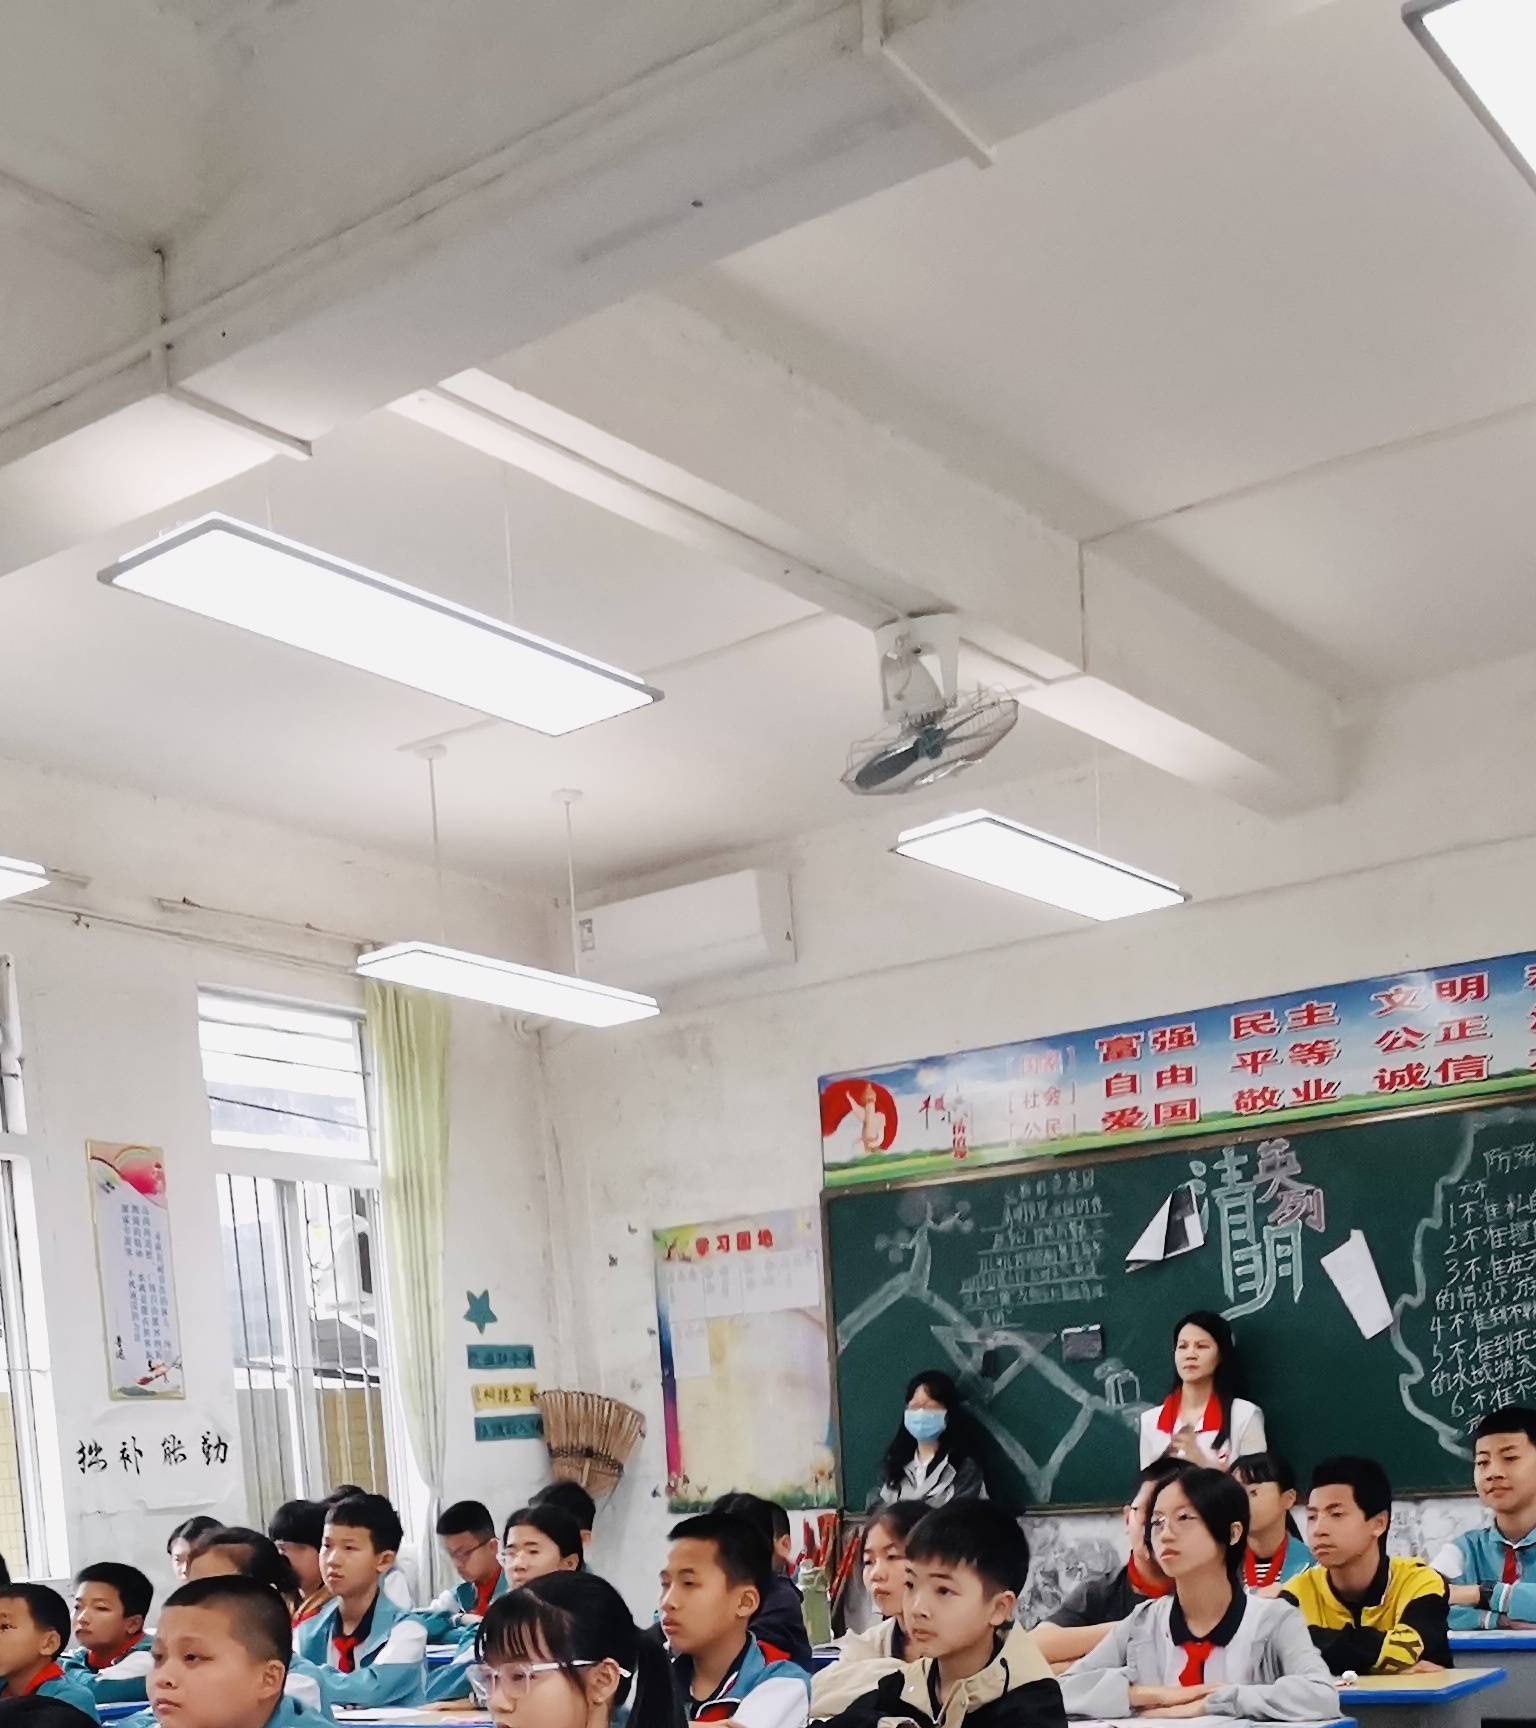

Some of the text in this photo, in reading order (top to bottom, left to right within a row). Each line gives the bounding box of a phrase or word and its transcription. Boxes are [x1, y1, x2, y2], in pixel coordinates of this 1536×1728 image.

[1098, 1023, 1199, 1063] 富强
[1231, 1000, 1341, 1040] 民主
[1370, 972, 1489, 1018] 文明
[1104, 1063, 1197, 1099] 自由
[1231, 1037, 1341, 1076] 平等
[1373, 1014, 1491, 1054] 公正
[1101, 1096, 1201, 1134] 爱国
[1233, 1078, 1341, 1115] 敬业
[1373, 1053, 1492, 1094] 诚信
[695, 1229, 773, 1257] 学习园地
